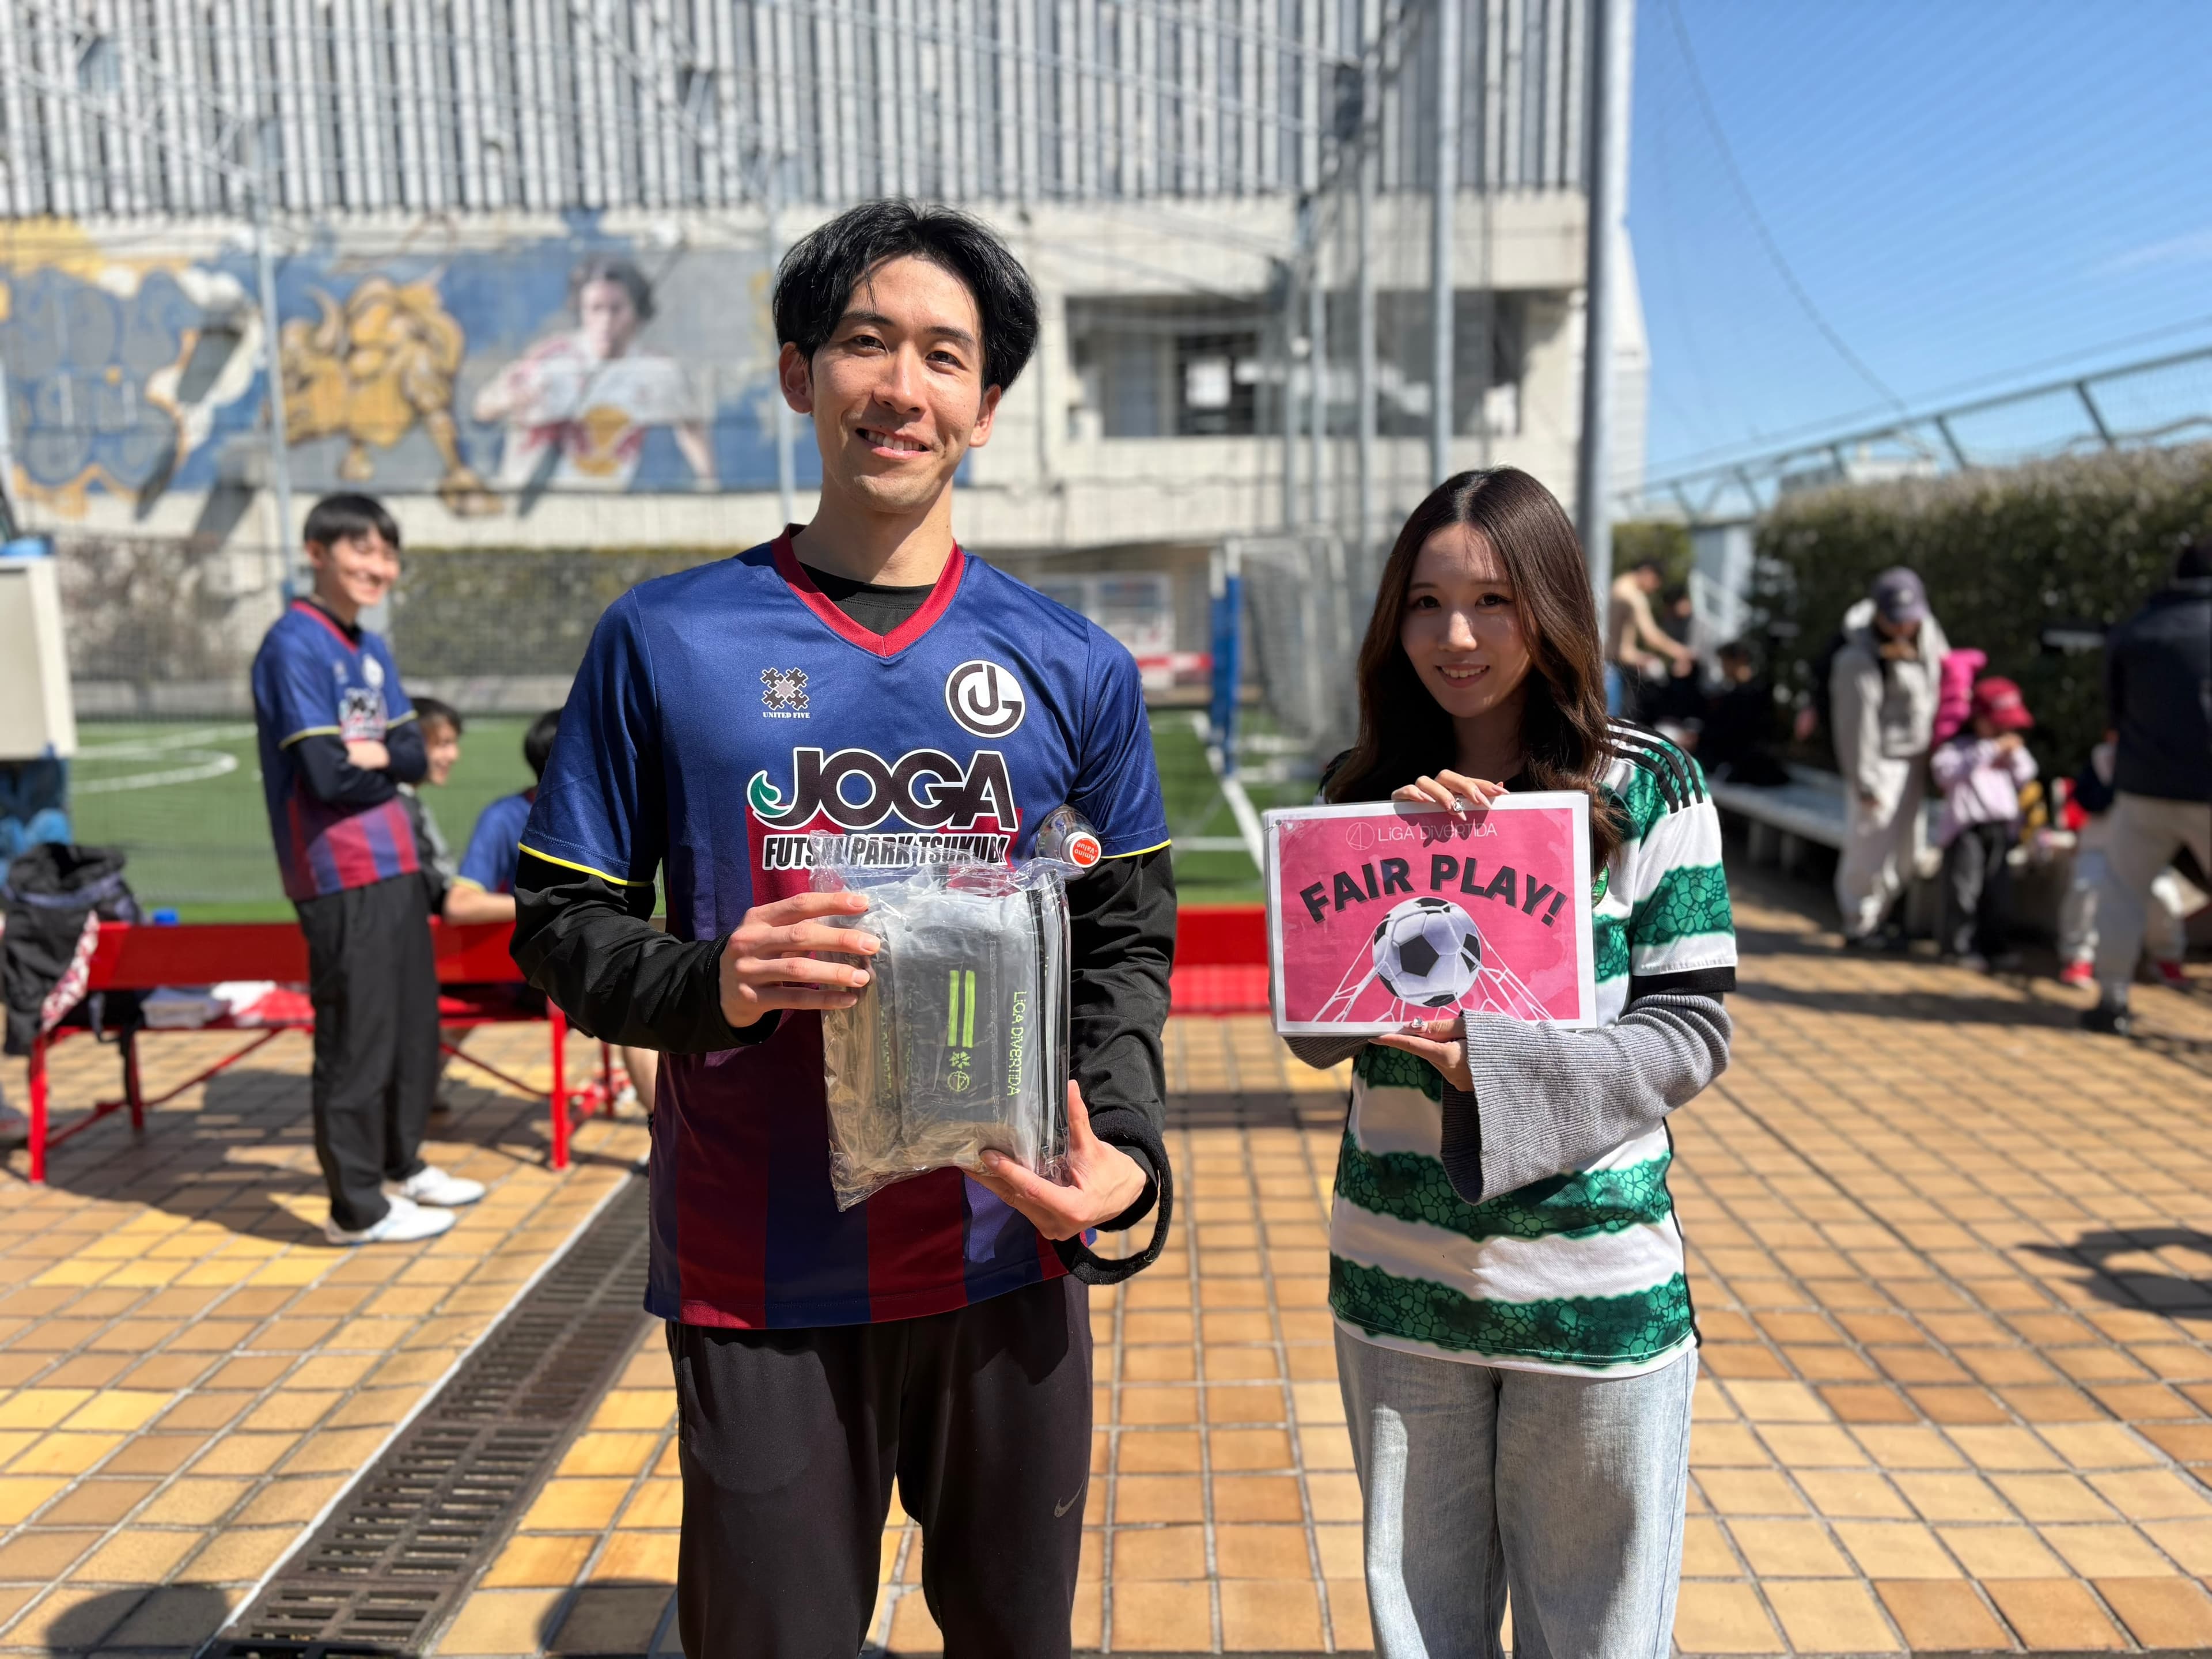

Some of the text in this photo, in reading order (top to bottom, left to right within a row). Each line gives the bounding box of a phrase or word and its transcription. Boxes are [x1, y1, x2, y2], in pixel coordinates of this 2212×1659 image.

[749, 748, 1018, 830] JOGA
[850, 835, 916, 867] PARK
[1074, 849, 1096, 861] Amino
[1077, 842, 1094, 854] Value
[1300, 854, 1567, 926] FAIR PLAY!
